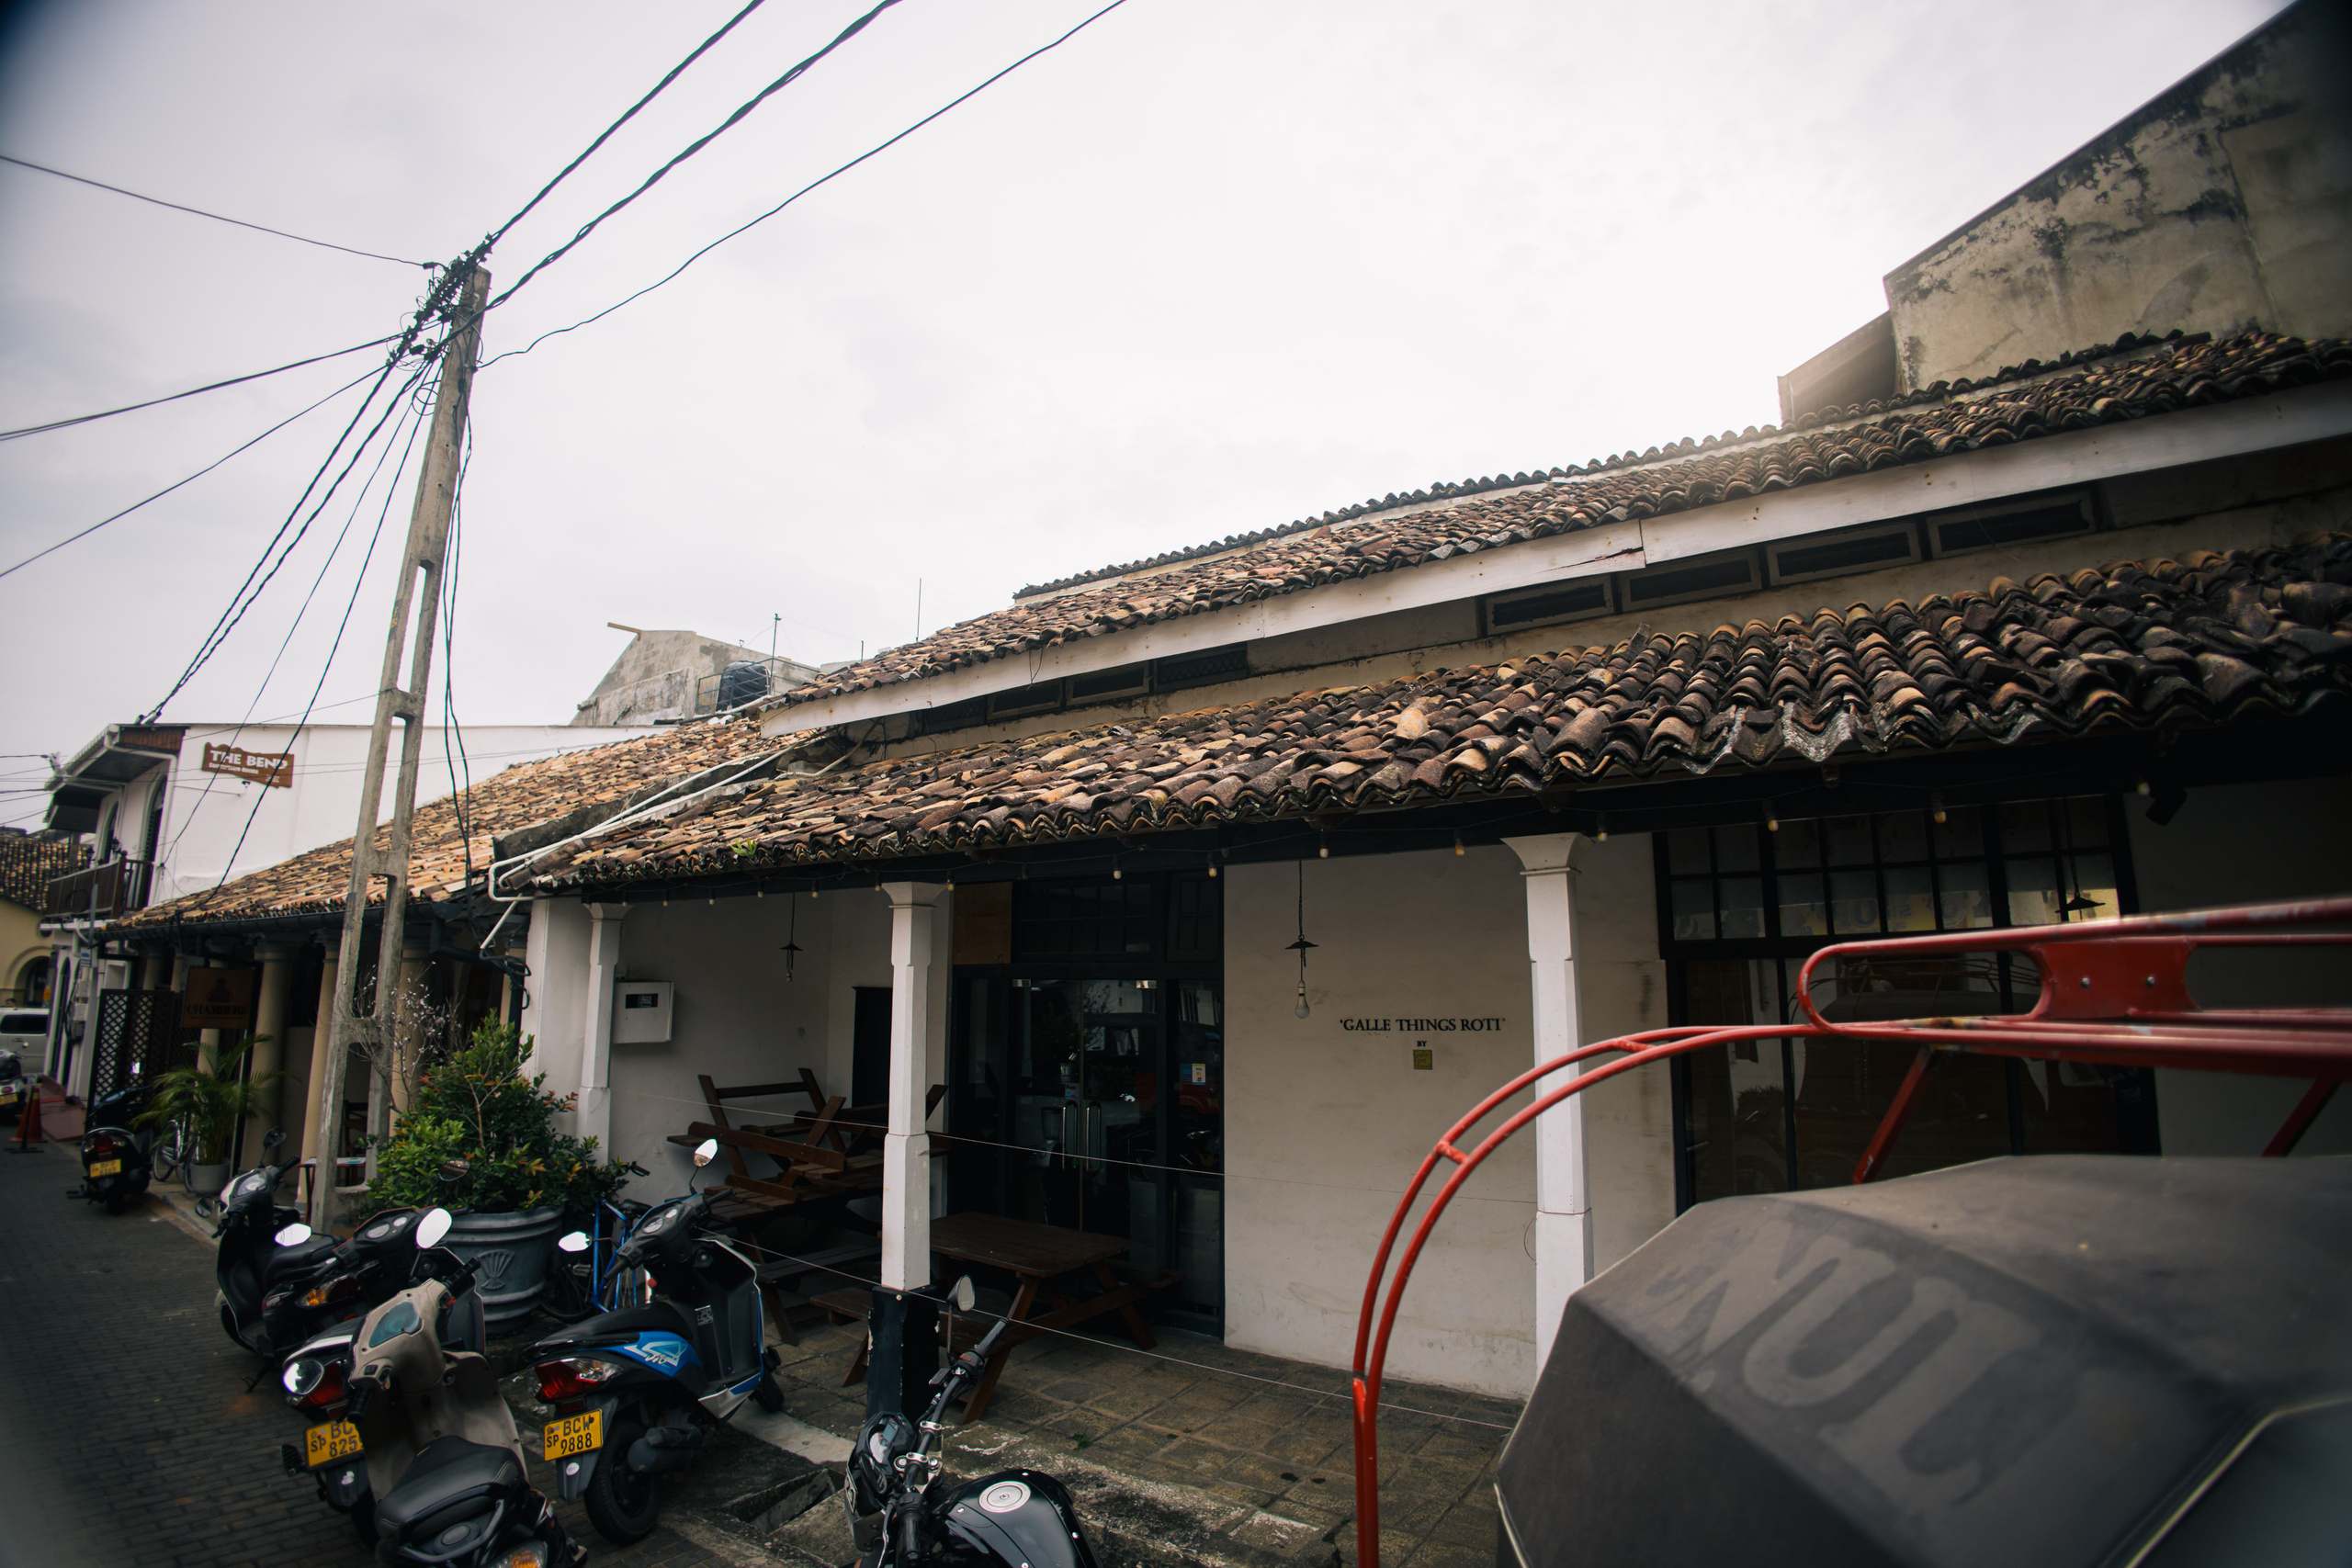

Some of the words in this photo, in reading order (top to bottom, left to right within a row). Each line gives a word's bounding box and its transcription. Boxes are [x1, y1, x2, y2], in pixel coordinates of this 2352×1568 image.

[209, 750, 242, 765] THE
[246, 755, 288, 770] BEND
[187, 1004, 248, 1015] CHAMBERS
[1396, 1019, 1456, 1032] THINGS
[331, 1420, 354, 1438] BC
[563, 1415, 592, 1437] BCW
[311, 1437, 327, 1452] SP
[329, 1434, 362, 1458] 825
[547, 1434, 560, 1448] SP
[560, 1432, 593, 1455] 9888
